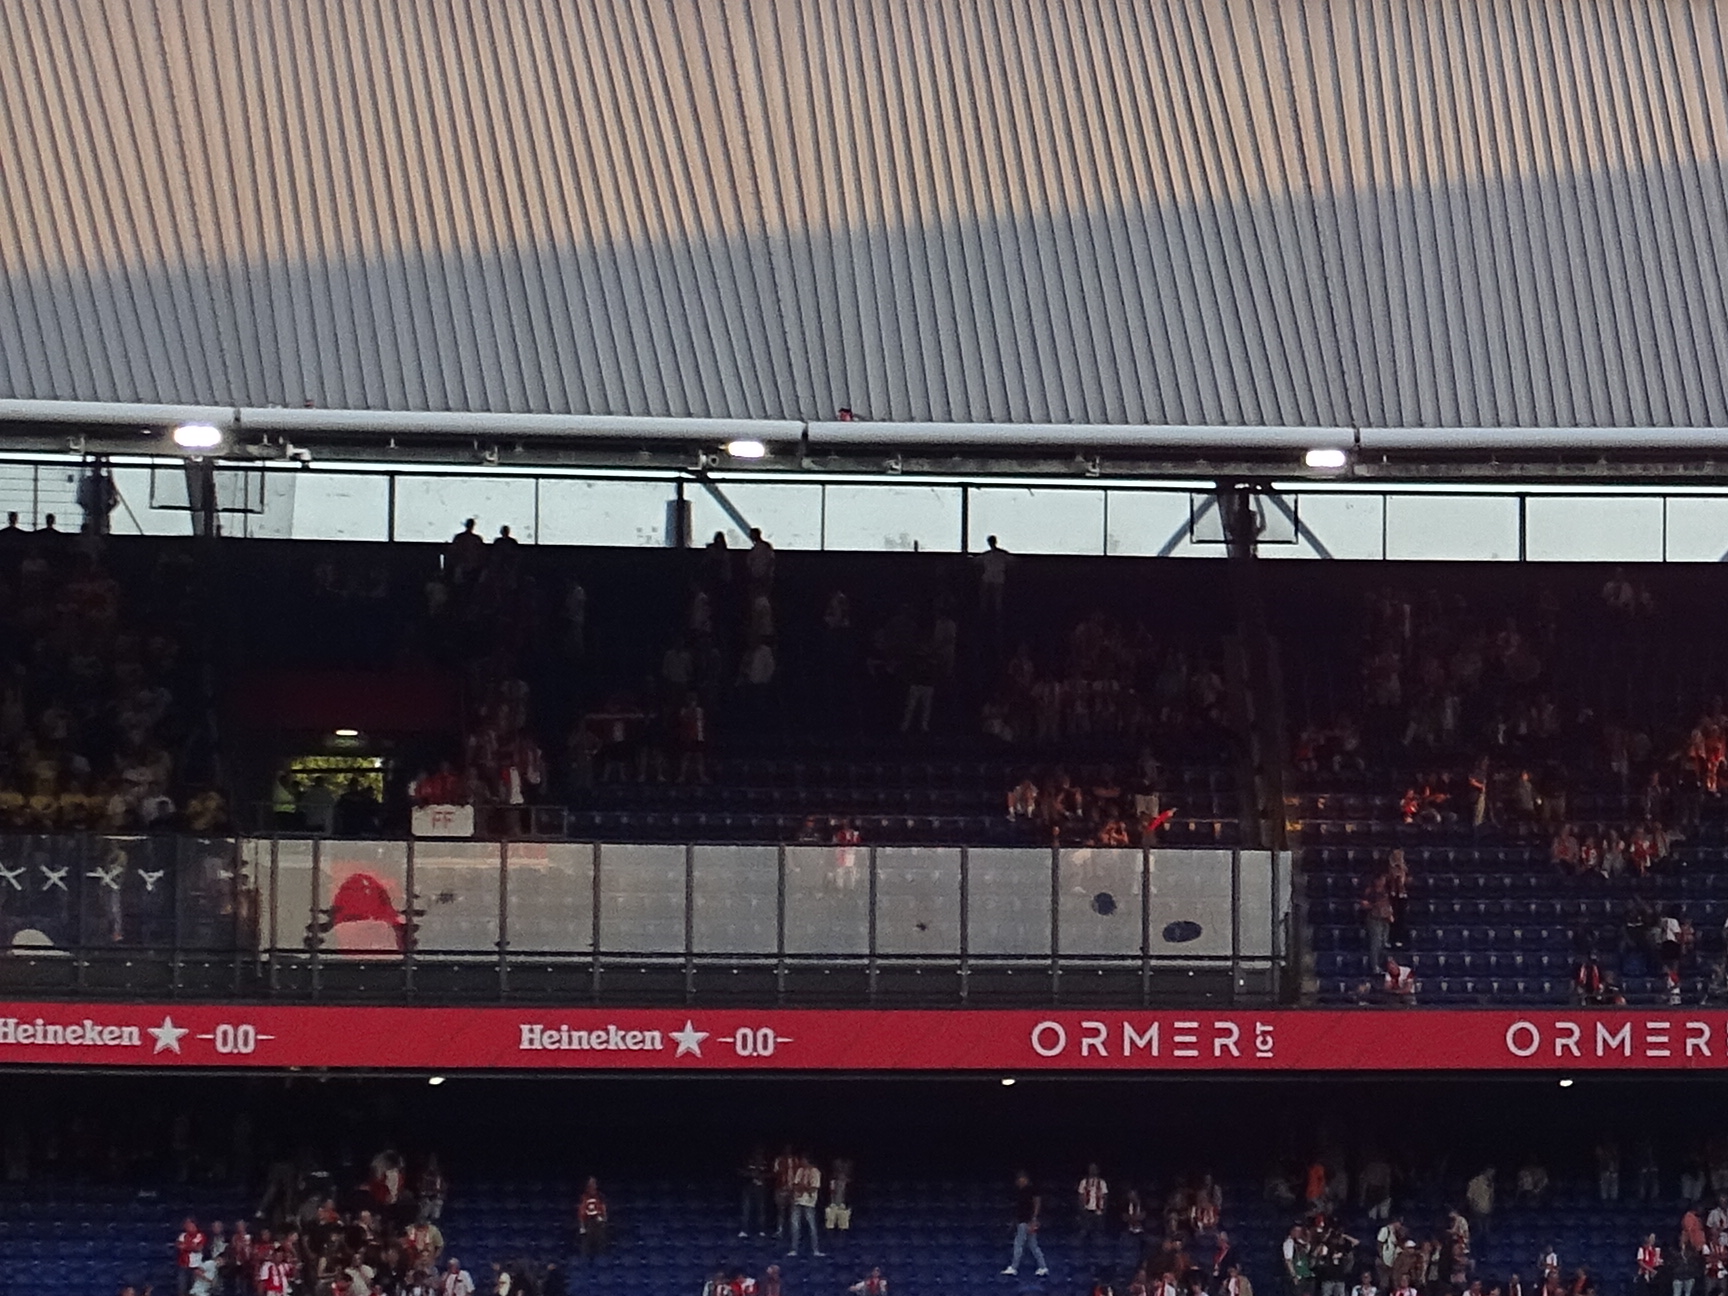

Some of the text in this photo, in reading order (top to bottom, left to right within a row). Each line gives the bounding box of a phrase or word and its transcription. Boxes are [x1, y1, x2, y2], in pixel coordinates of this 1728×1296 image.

[431, 810, 456, 830] FF
[0, 1017, 142, 1047] Heineken
[519, 1023, 664, 1051] Heineken
[1031, 1020, 1275, 1058] ORMER ICT
[1505, 1021, 1712, 1057] ORMER
